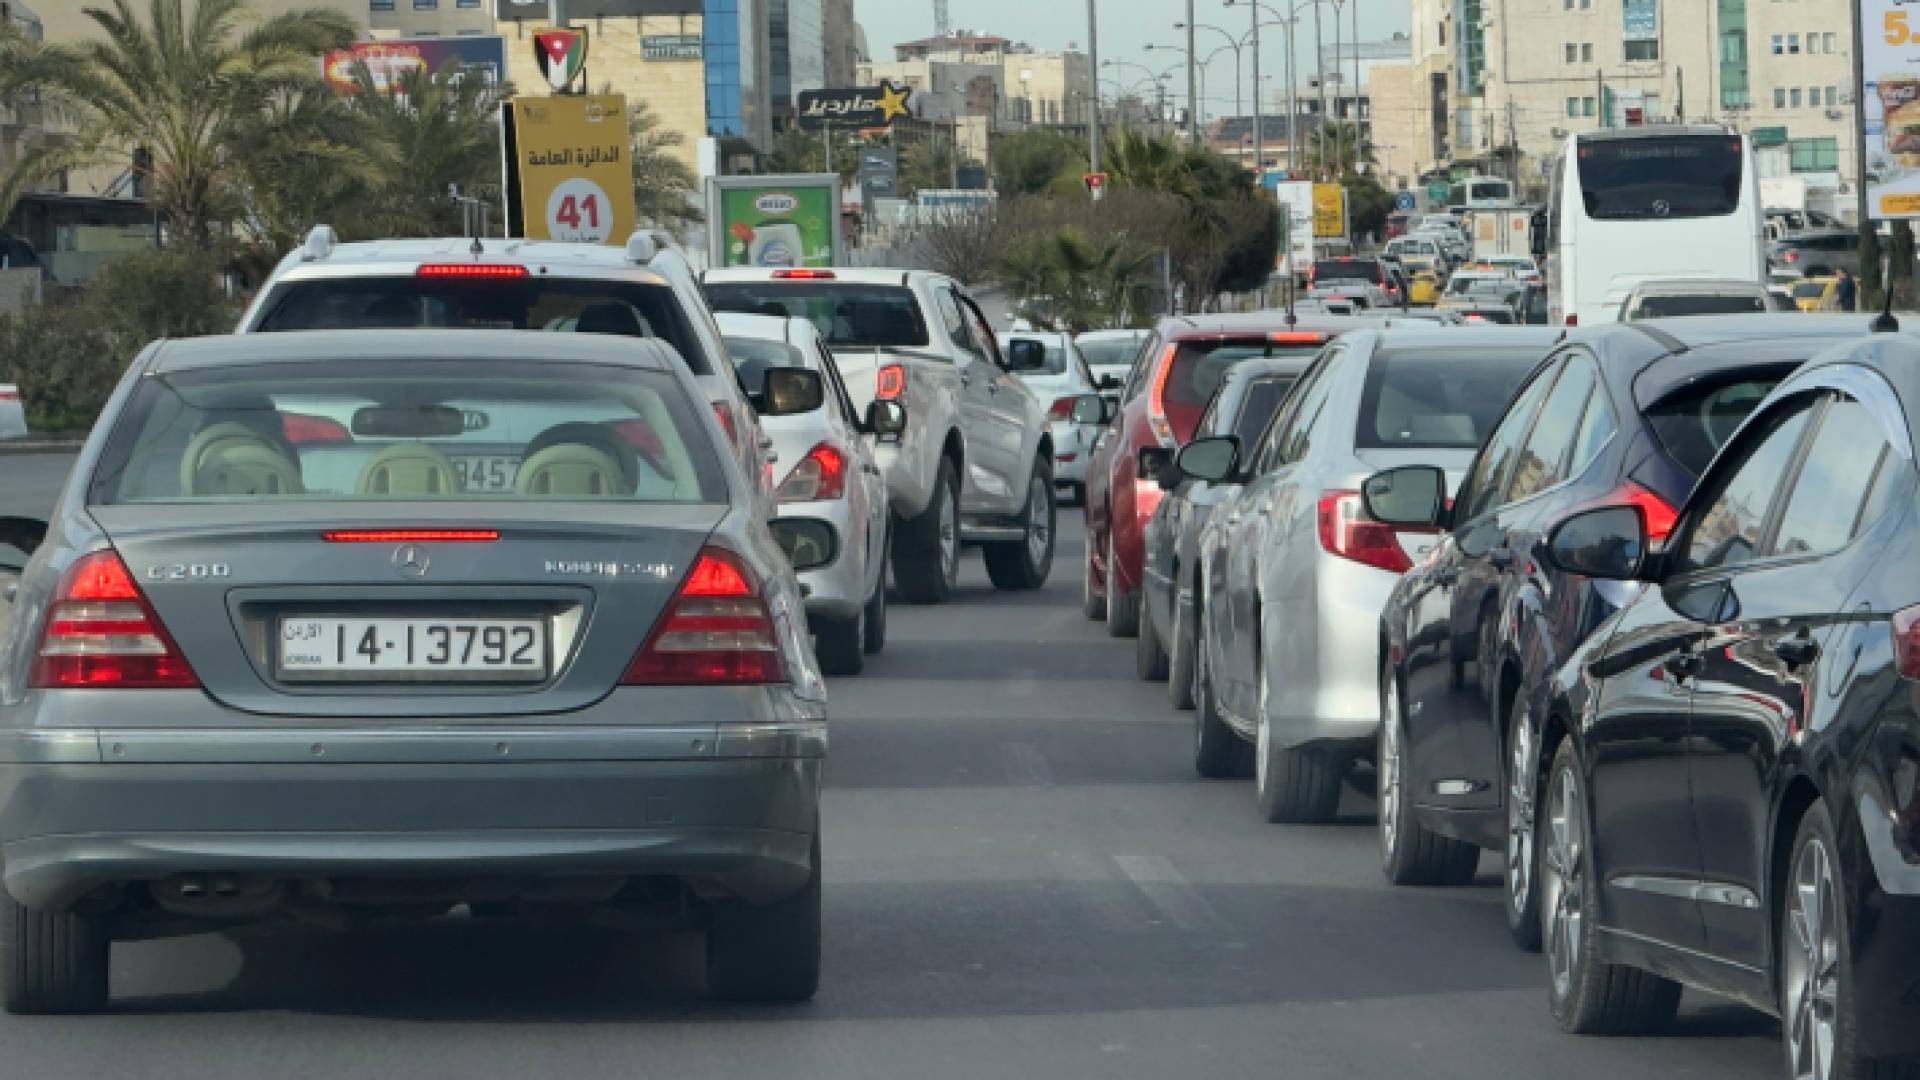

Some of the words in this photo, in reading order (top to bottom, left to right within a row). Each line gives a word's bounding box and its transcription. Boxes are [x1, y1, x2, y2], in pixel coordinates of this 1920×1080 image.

[528, 148, 574, 165] العامة
[577, 145, 619, 168] الدائرة
[556, 194, 599, 229] 41
[337, 624, 535, 665] 14-13792
[285, 655, 322, 665] JORDAN
